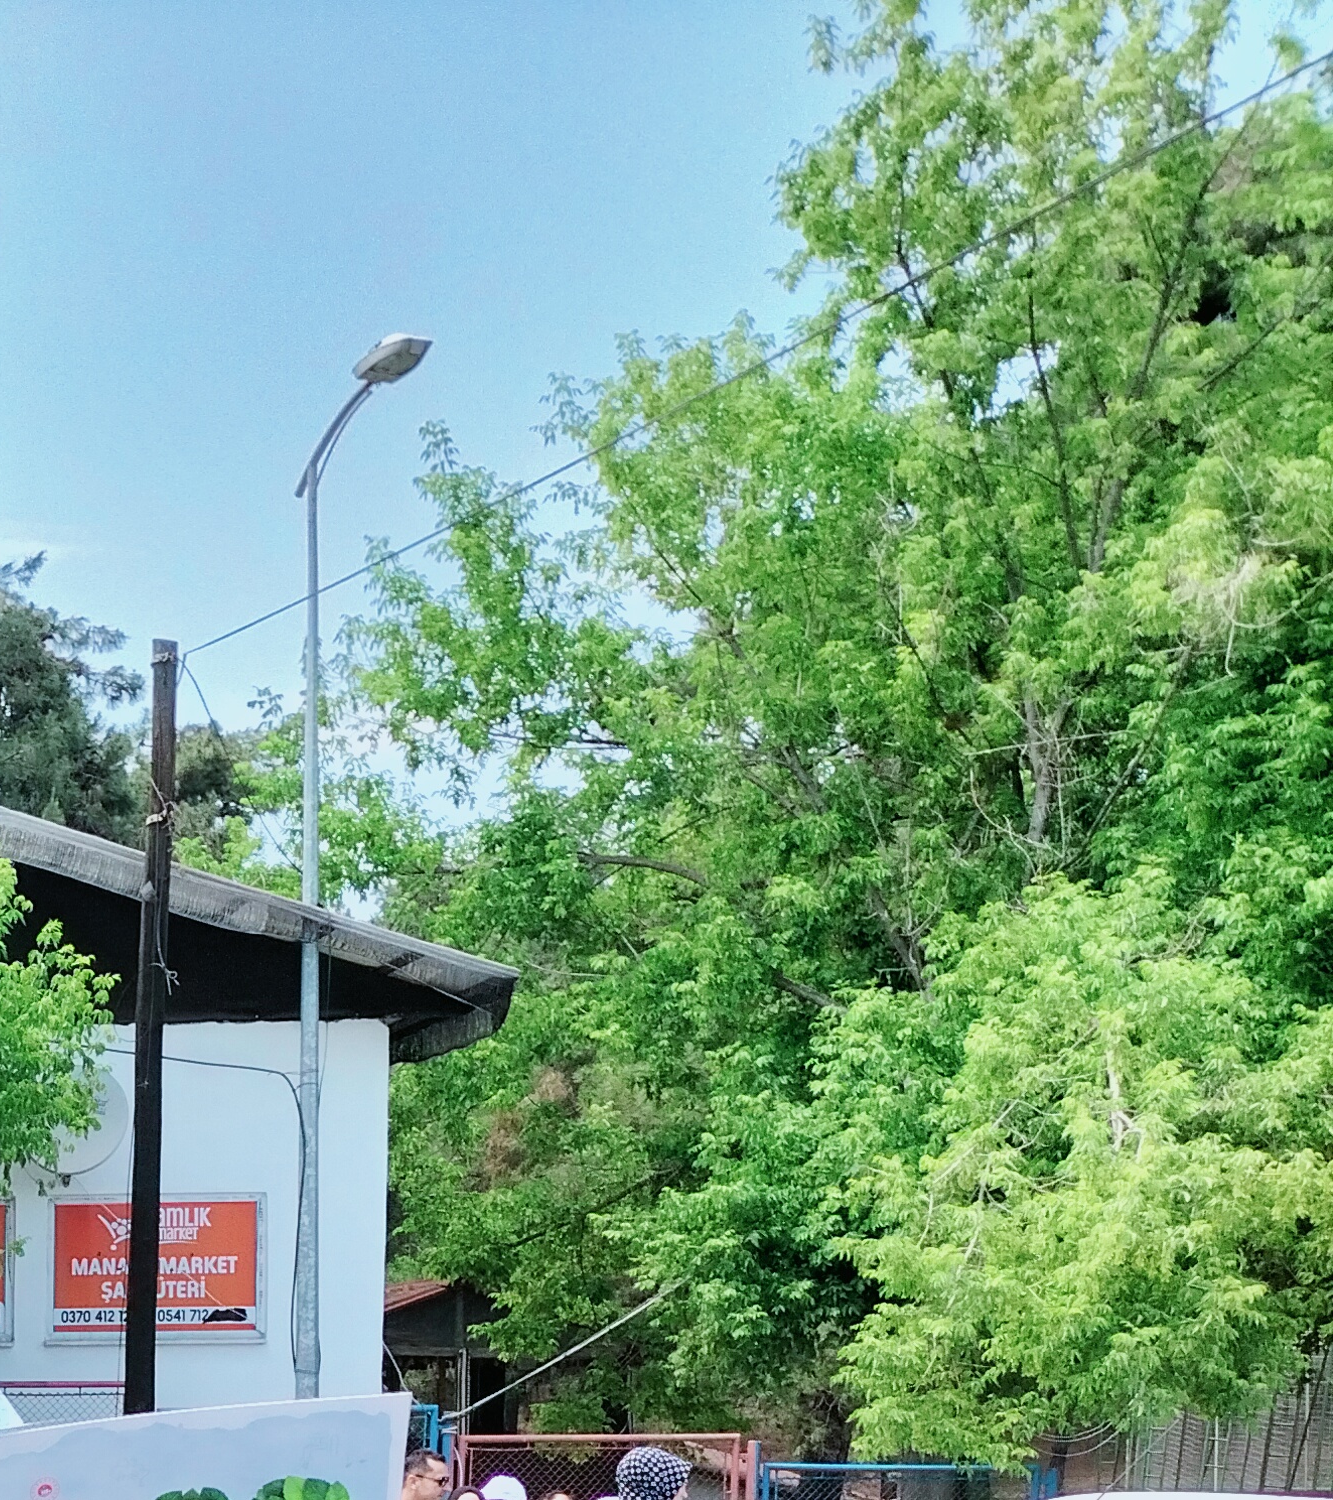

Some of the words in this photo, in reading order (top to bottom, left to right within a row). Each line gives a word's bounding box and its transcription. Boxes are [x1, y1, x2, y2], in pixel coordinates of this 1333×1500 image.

[158, 1255, 238, 1275] MARKET
[61, 1310, 91, 1324] 0370
[95, 1309, 115, 1323] 412
[157, 1309, 187, 1323] 0541
